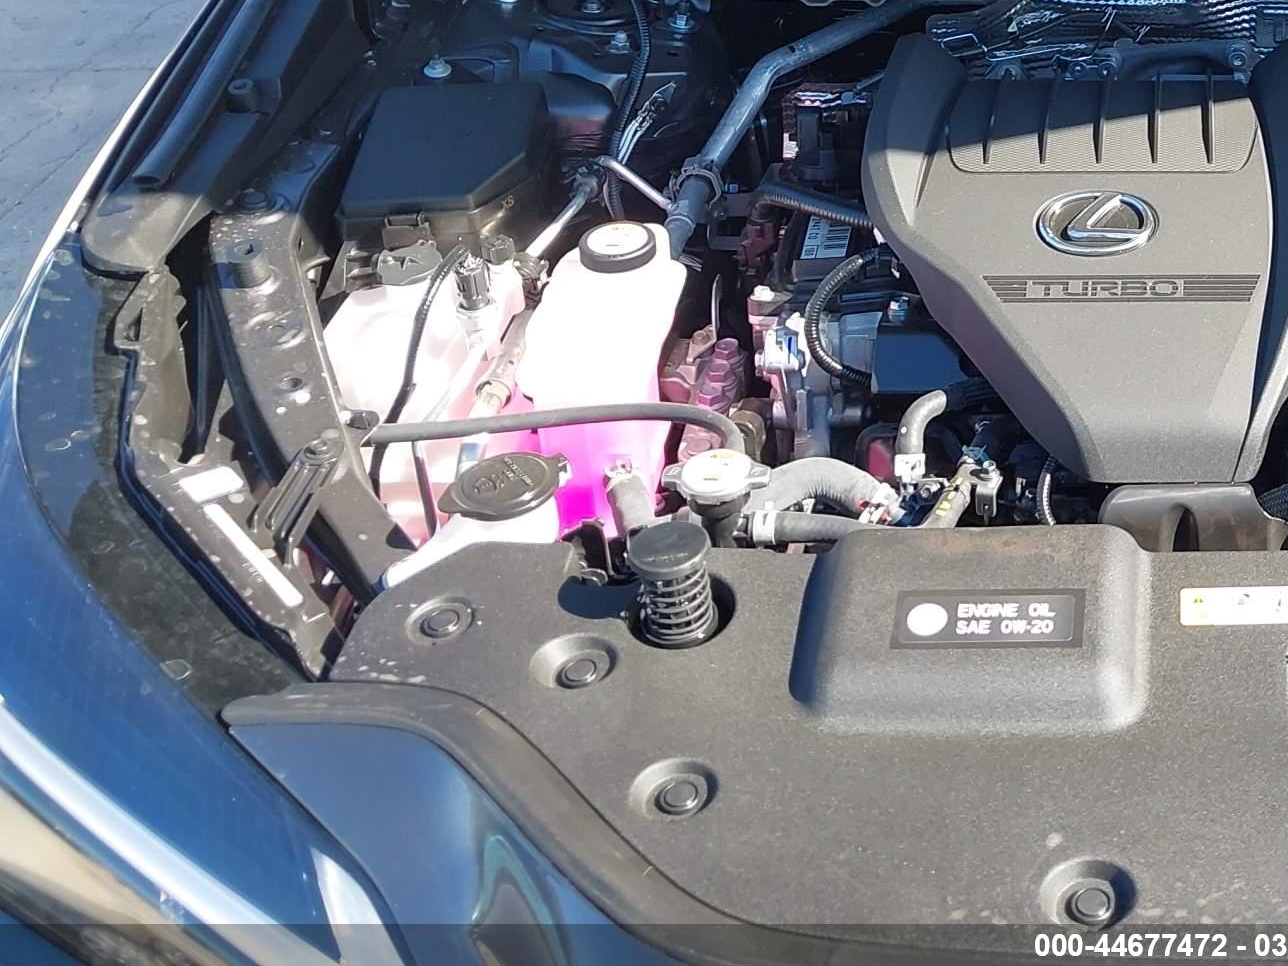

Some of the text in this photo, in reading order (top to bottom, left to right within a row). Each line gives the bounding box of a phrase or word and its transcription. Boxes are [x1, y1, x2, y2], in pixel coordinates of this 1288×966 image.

[1031, 280, 1178, 296] TURBO
[957, 603, 1056, 618] ENGINE OIL
[955, 619, 1055, 635] SAE 0W-20
